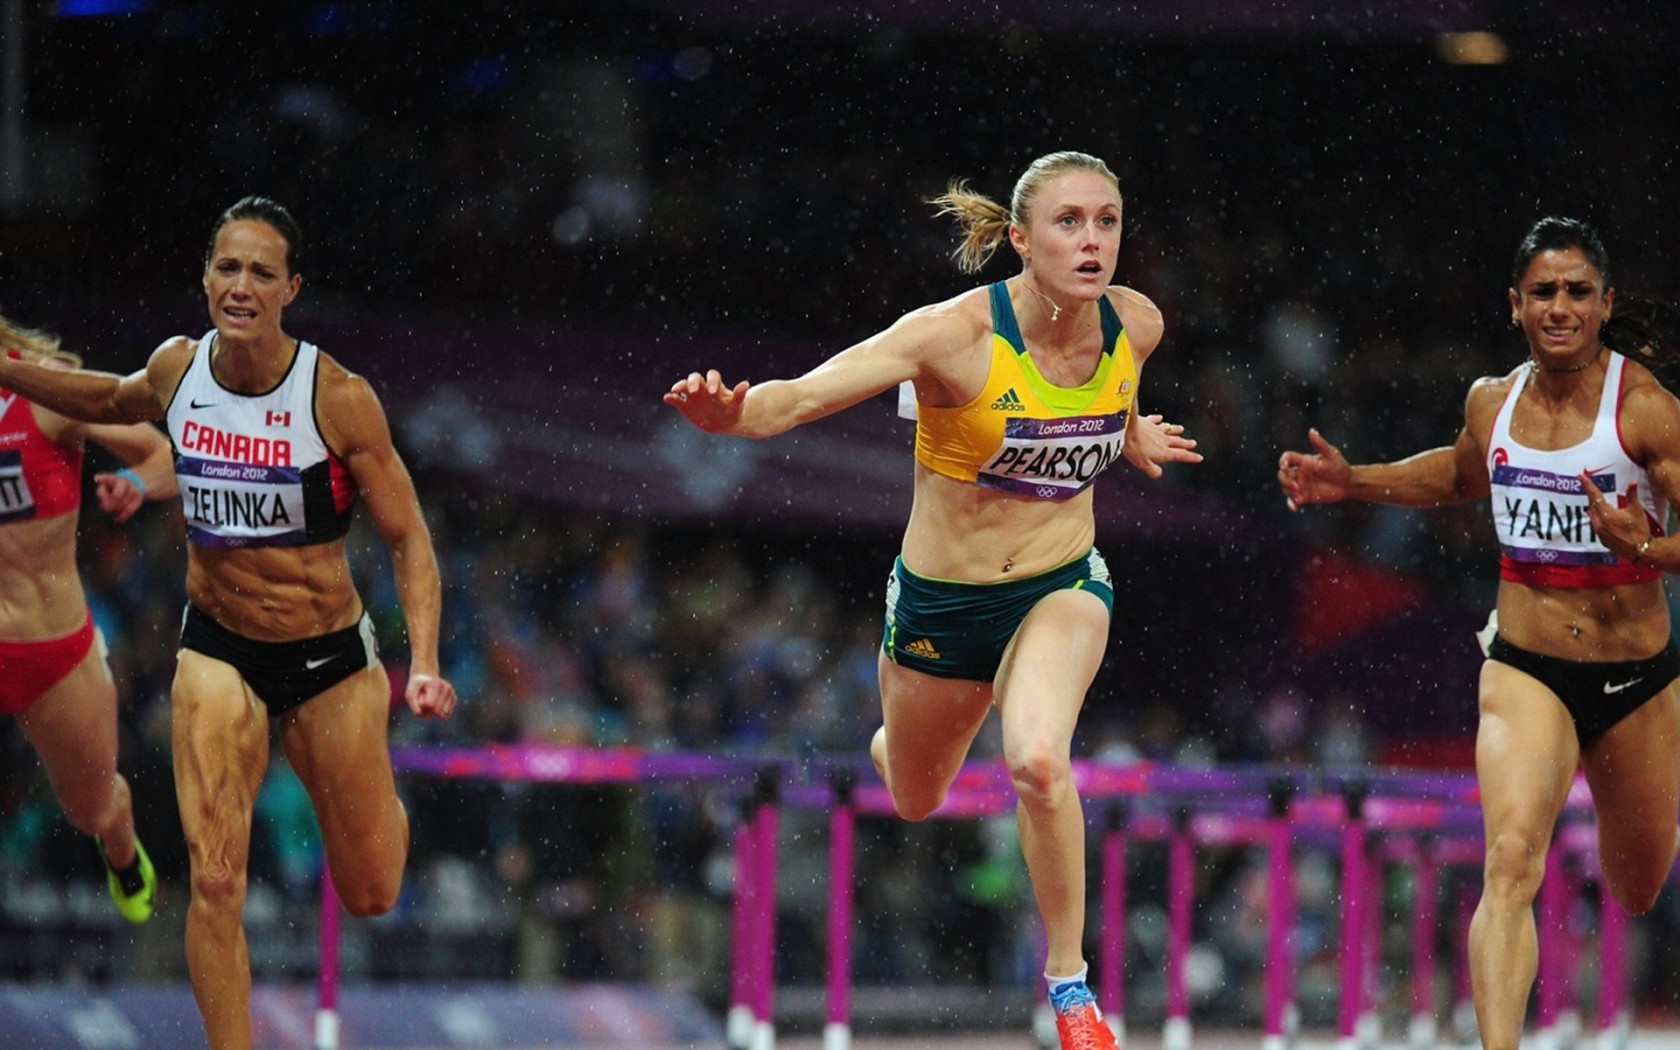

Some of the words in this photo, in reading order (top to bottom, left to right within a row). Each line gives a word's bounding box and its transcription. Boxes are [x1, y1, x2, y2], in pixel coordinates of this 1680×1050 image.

[991, 402, 1026, 412] adidas
[1038, 422, 1078, 434] London
[1079, 419, 1105, 432] 2012
[181, 420, 291, 467] CANADA
[201, 463, 240, 477] London
[242, 467, 268, 480] 2012
[1517, 475, 1555, 488] London
[1556, 478, 1582, 491] 2012
[188, 485, 290, 528] ZELINKA
[905, 645, 940, 659] adidas
